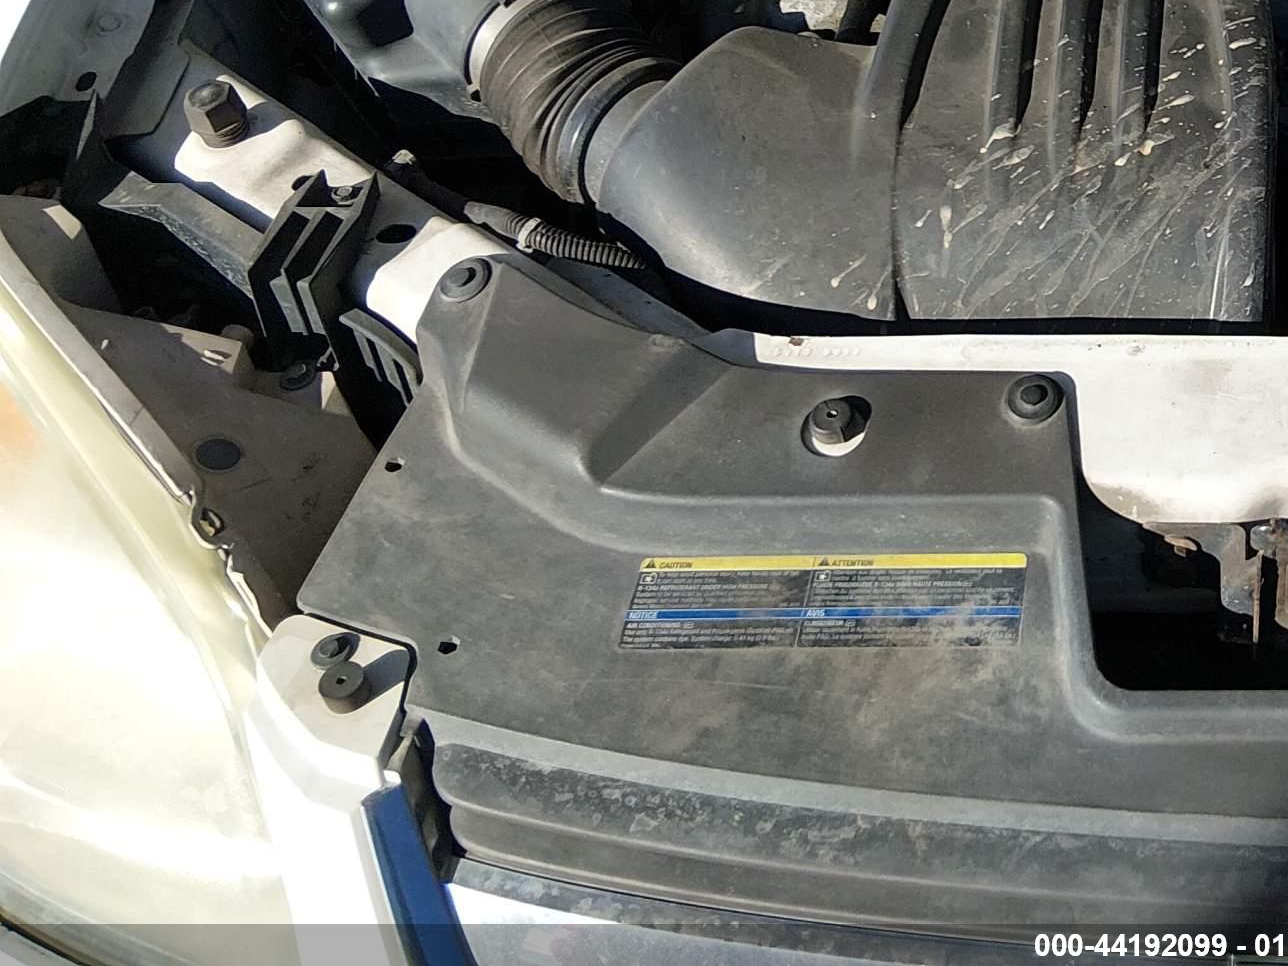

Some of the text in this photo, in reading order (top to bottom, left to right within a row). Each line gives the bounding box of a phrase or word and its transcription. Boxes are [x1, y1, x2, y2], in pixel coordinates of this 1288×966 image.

[659, 561, 692, 569] CAUTION
[831, 559, 874, 567] ATTENTION
[628, 611, 658, 619] NOTICE
[806, 609, 825, 617] AVIS
